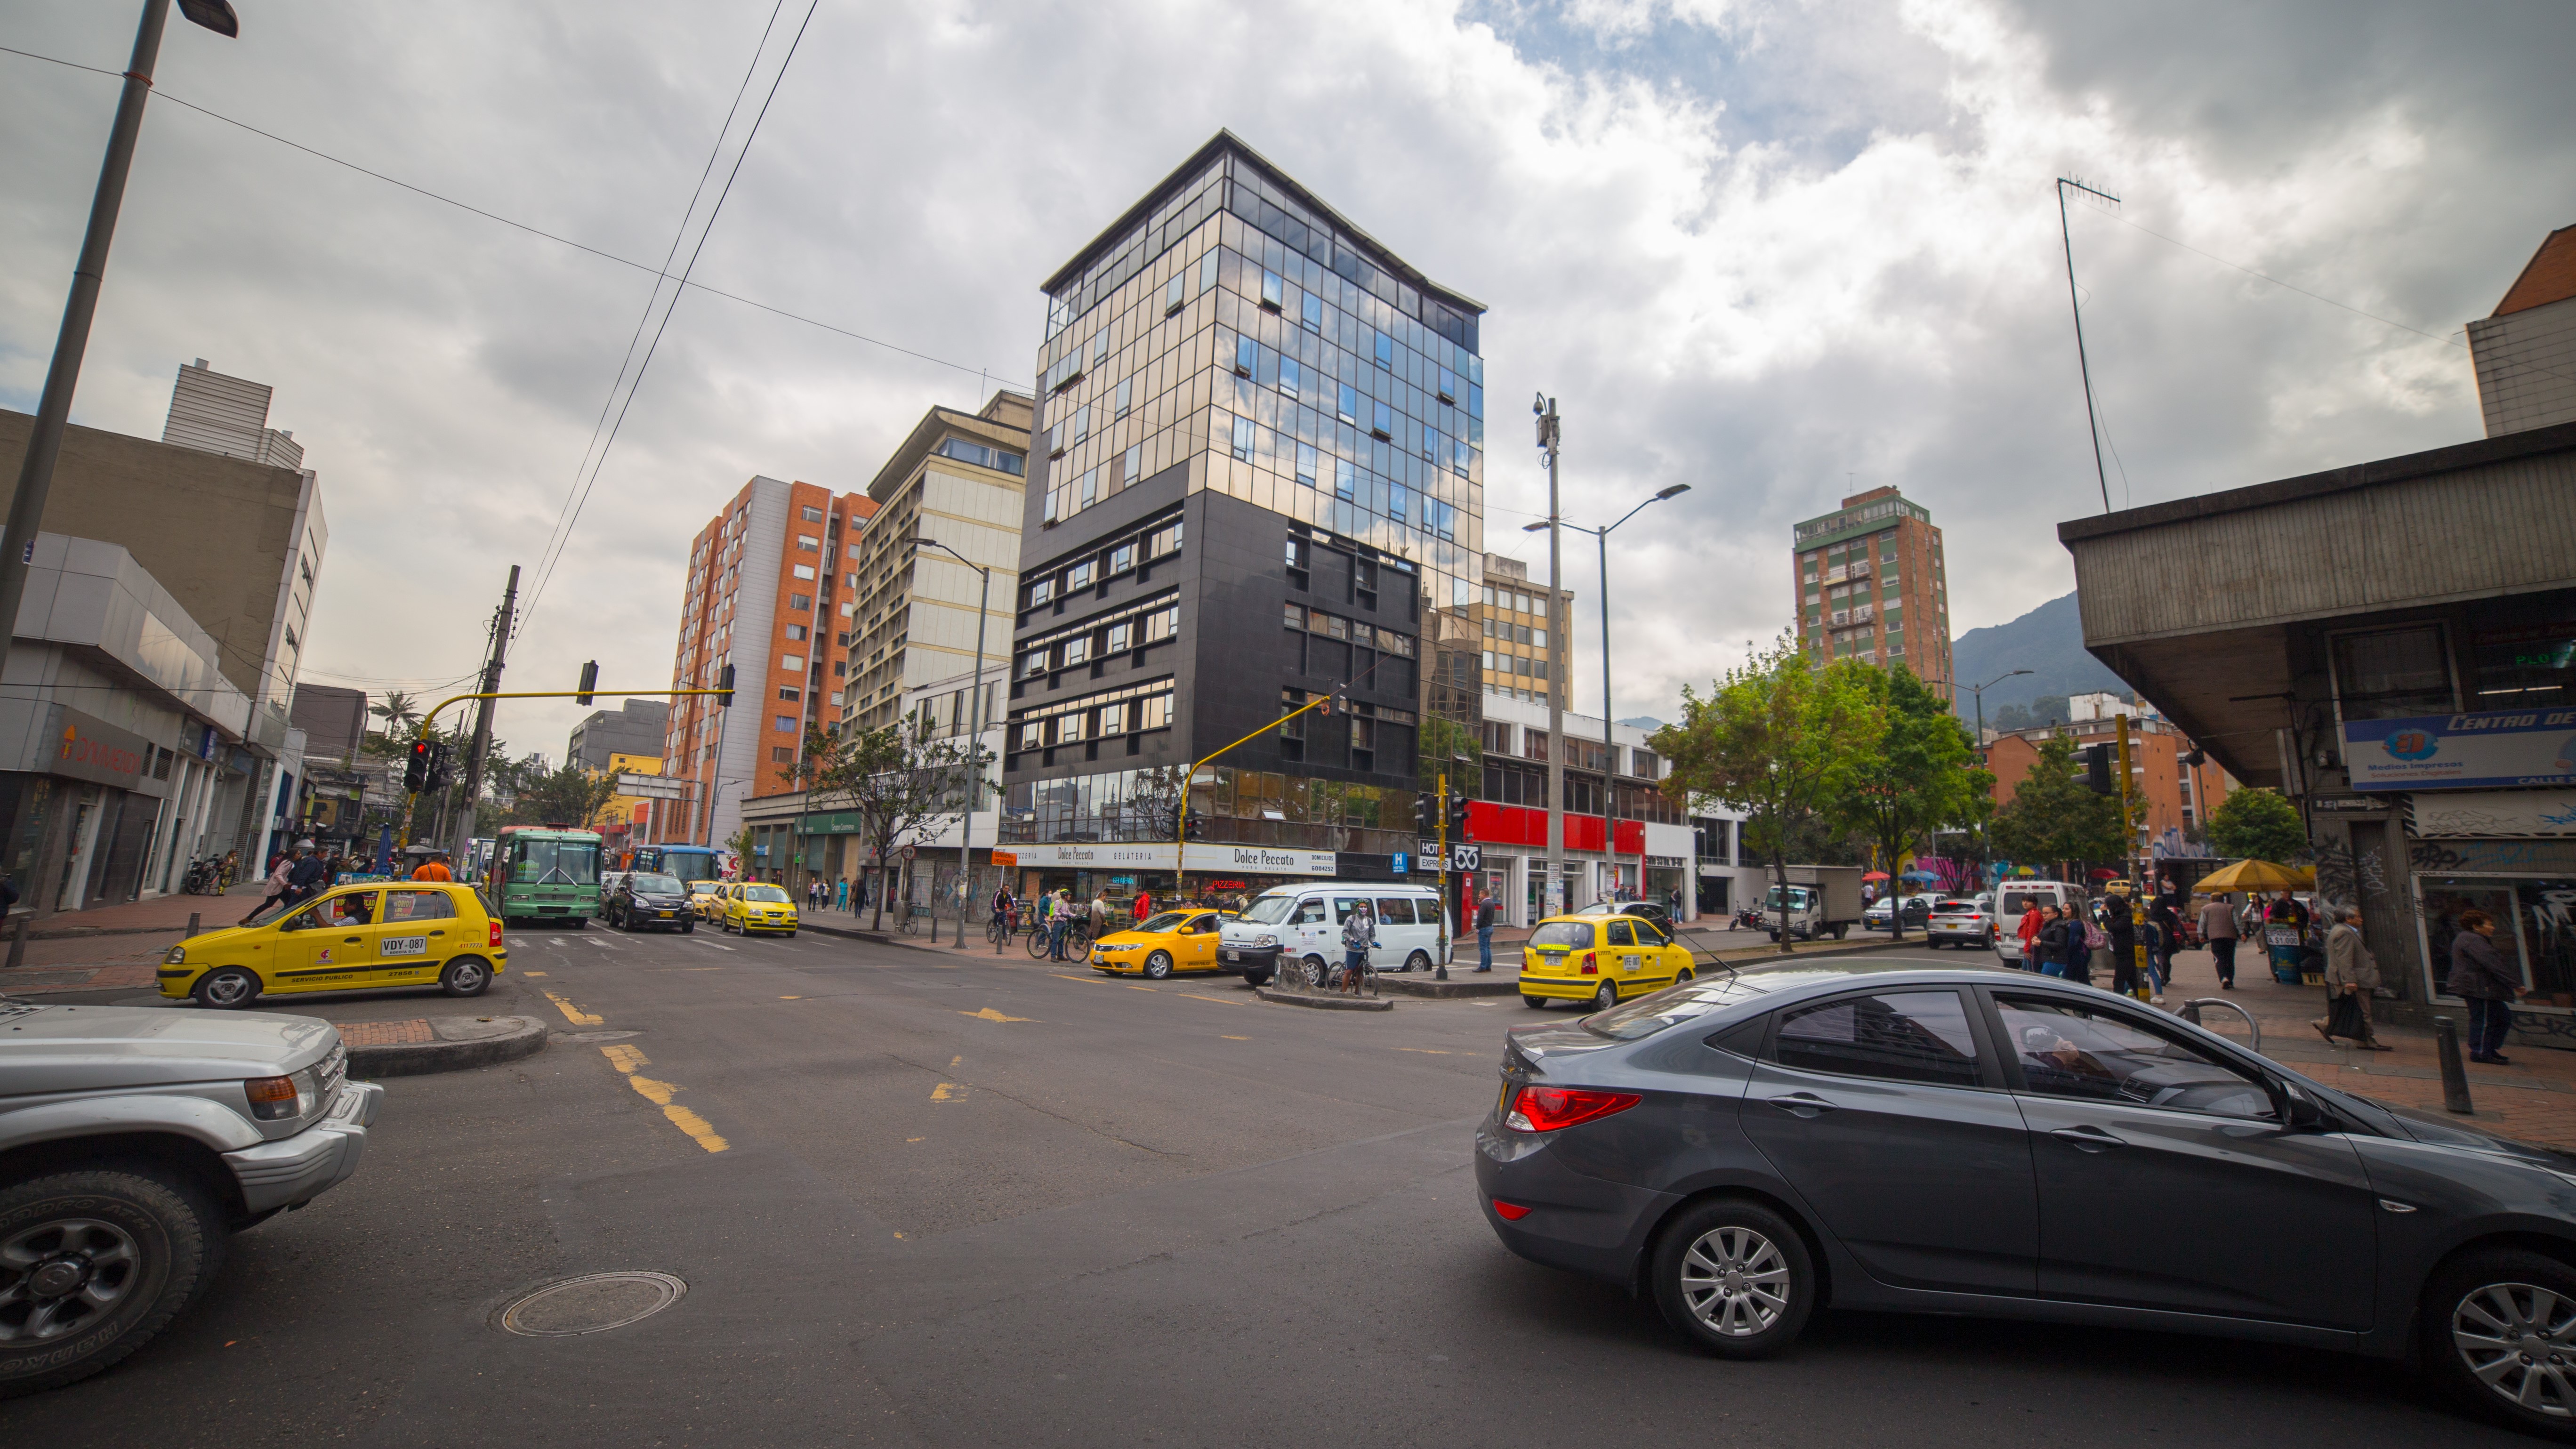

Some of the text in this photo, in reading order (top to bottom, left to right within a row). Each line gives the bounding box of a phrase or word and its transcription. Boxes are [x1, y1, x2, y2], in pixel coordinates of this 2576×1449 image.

[2410, 762, 2463, 771] Impresos
[831, 824, 840, 832] Grupo
[1058, 847, 1094, 860] Dolce Peccato
[1235, 849, 1258, 864] Dolce
[1261, 851, 1294, 866] Peccato
[1455, 845, 1478, 870] 53
[1395, 853, 1402, 865] H
[1112, 877, 1134, 885] GELATERIA
[1212, 880, 1246, 889] PIZZERIA
[1624, 957, 1640, 966] VFE-007
